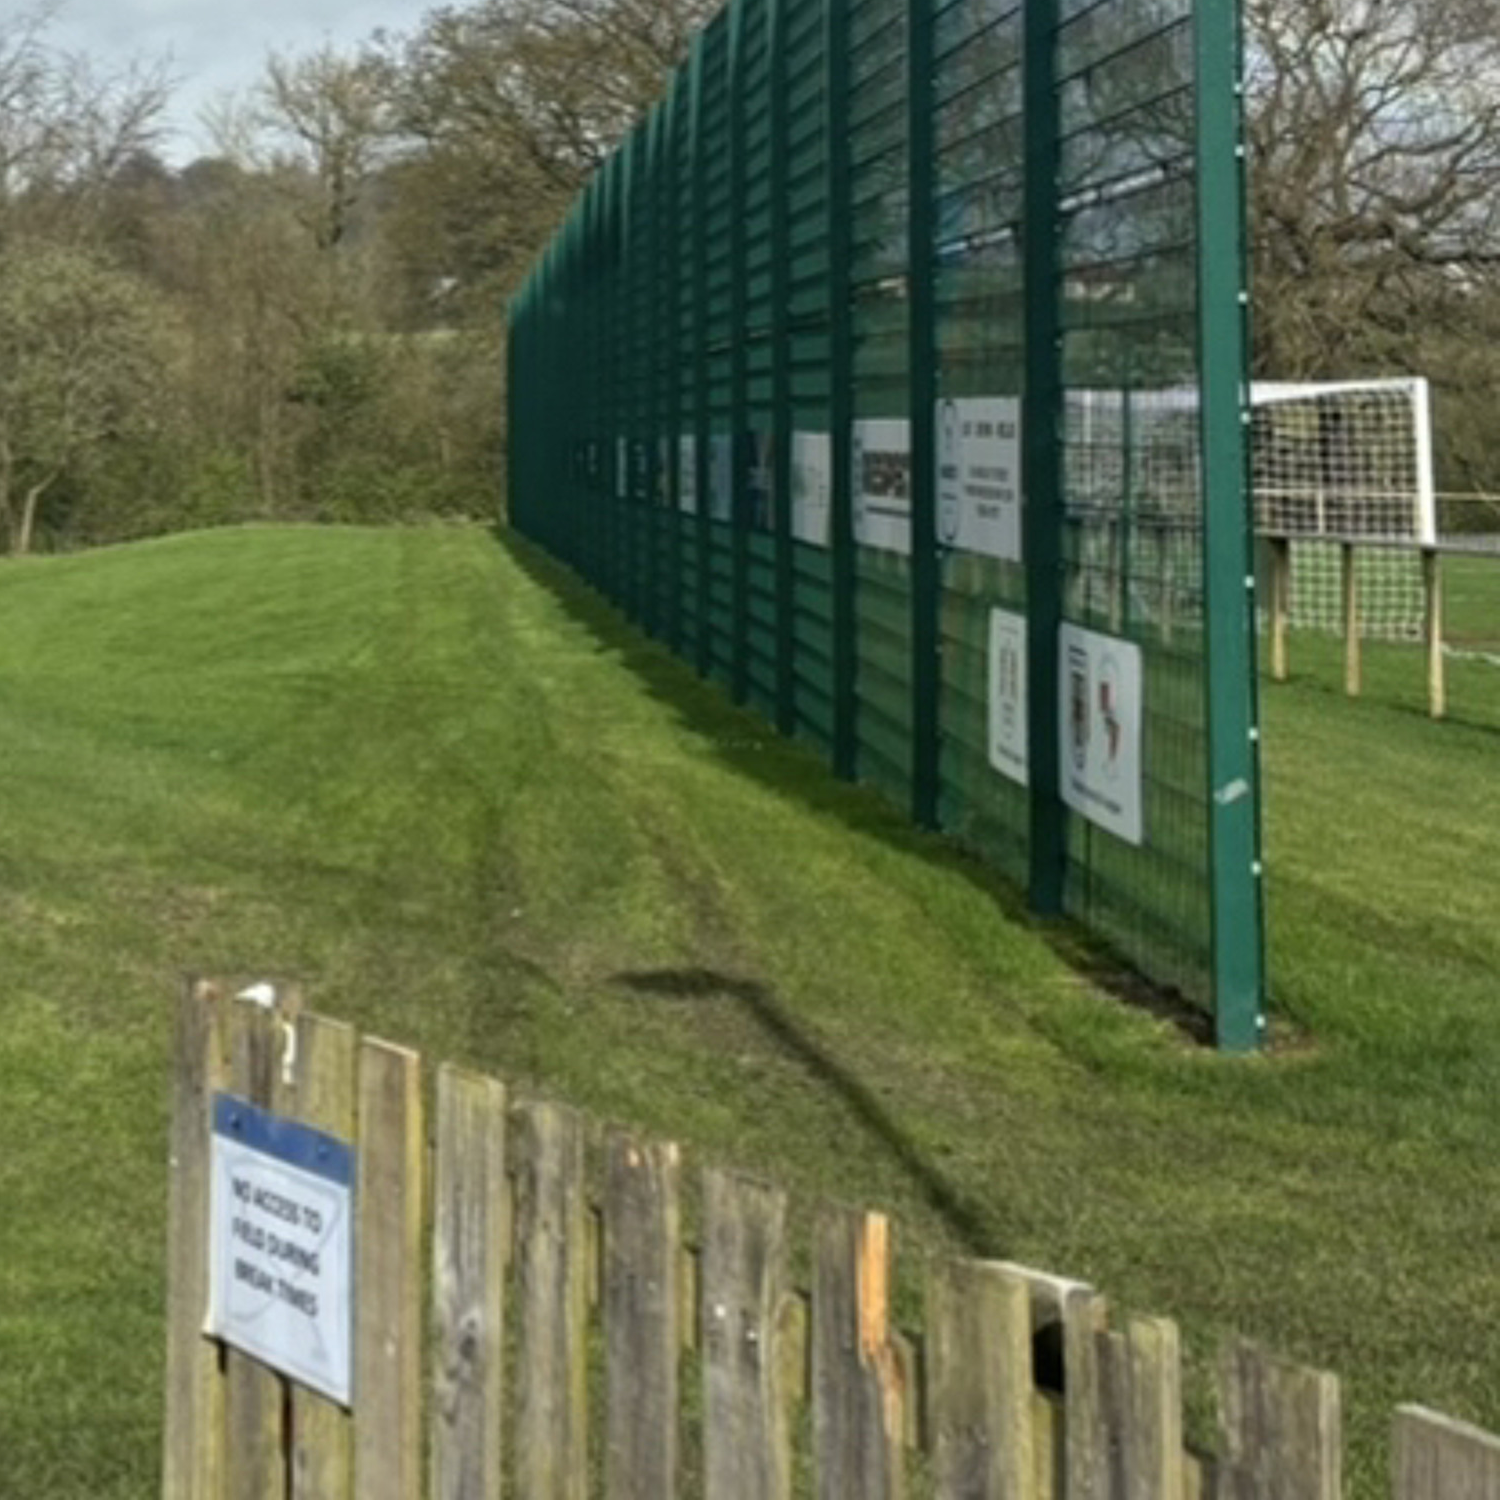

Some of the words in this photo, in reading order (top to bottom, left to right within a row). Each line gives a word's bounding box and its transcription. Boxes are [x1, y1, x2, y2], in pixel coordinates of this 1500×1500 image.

[232, 1178, 252, 1202] NO
[254, 1187, 300, 1225] ACCESS
[301, 1207, 323, 1234] TO
[232, 1217, 265, 1250] FIELD
[266, 1233, 320, 1276] DURING
[235, 1258, 273, 1294] BREAK
[278, 1276, 318, 1318] TIMES
